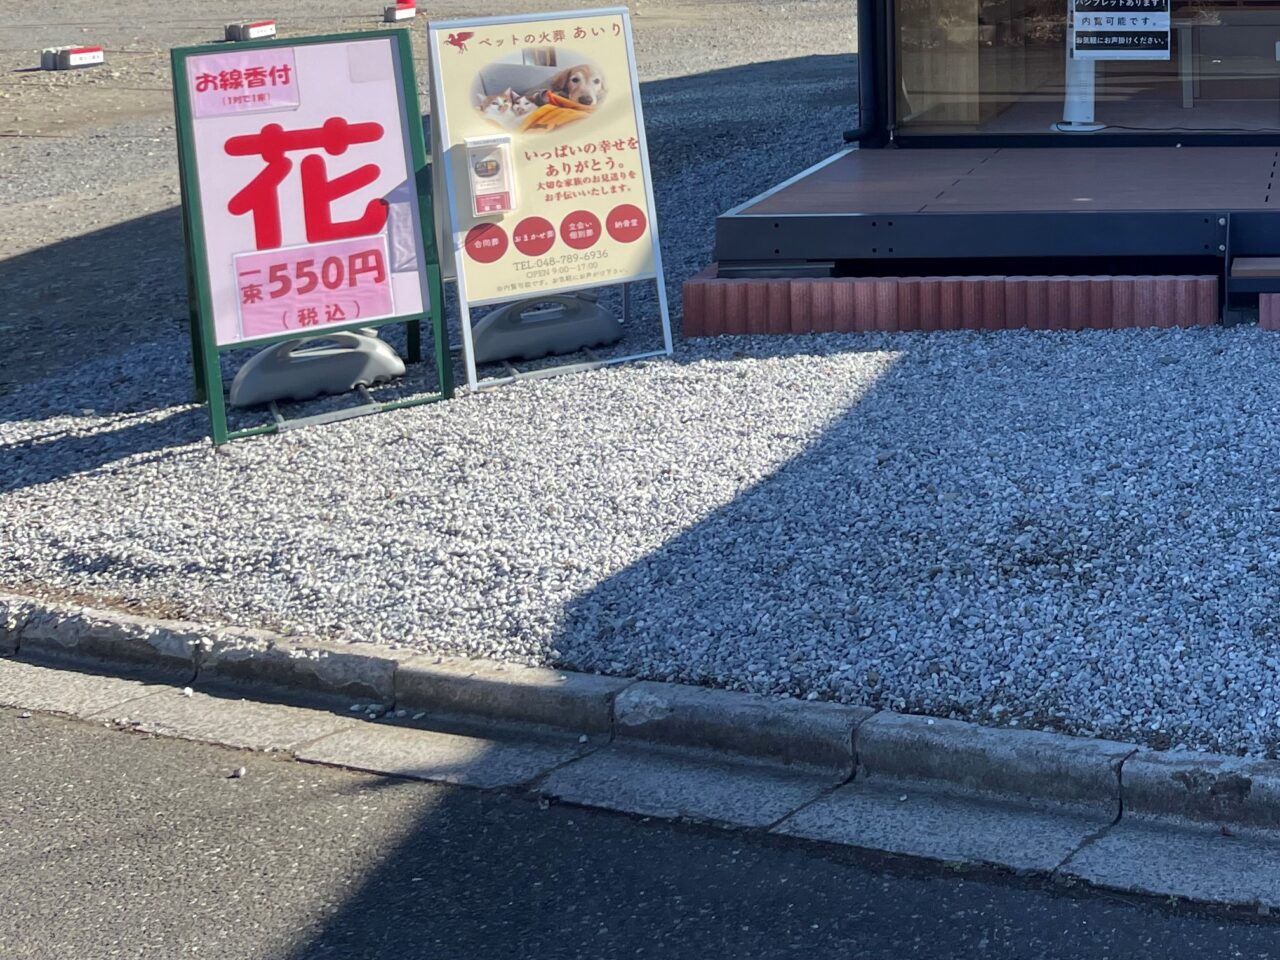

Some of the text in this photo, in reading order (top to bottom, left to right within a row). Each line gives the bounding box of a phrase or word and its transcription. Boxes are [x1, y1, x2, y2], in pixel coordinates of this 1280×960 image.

[479, 22, 621, 47] ペットの火葬 あいり
[195, 63, 292, 93] お線香付
[524, 136, 639, 161] いっぱいの幸せを
[545, 156, 625, 177] ありがとう。
[224, 117, 390, 251] 花
[536, 170, 637, 191] 大切な家族のお見送りを
[268, 249, 386, 299] 550円
[526, 266, 550, 279] OPEN
